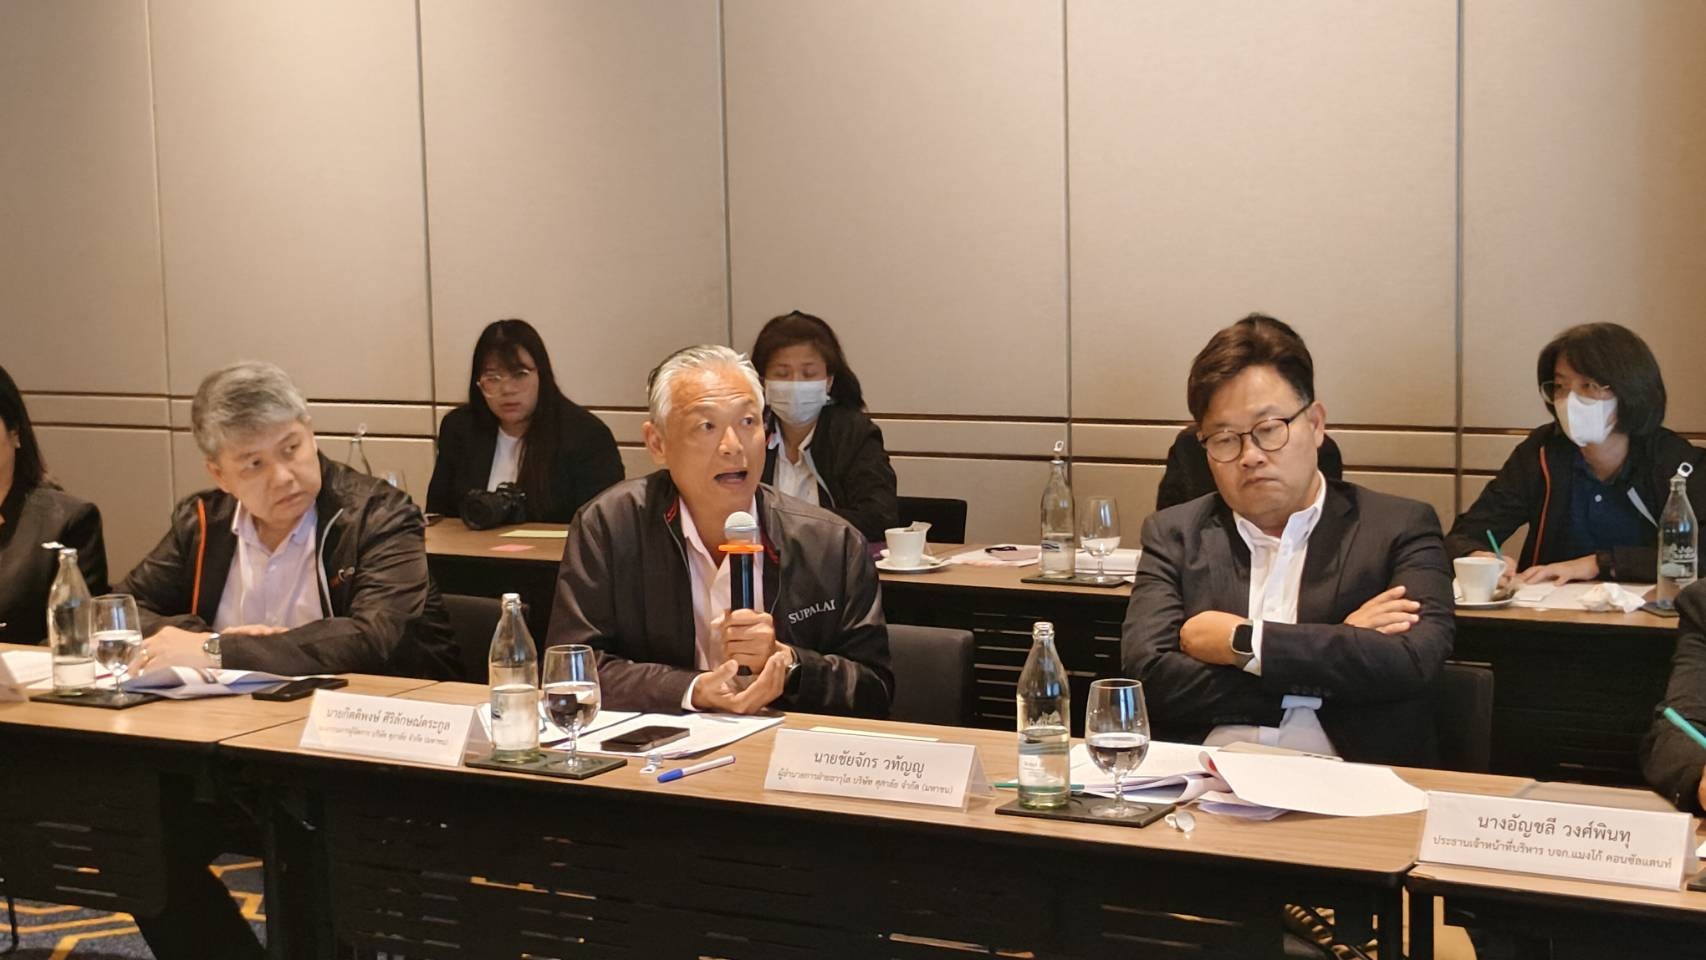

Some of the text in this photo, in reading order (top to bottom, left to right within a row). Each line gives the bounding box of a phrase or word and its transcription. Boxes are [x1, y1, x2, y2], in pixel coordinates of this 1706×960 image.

[788, 599, 836, 624] SUPALAI
[326, 707, 382, 723] นายกิตติพงษ์
[814, 750, 926, 779] นายชัยจักร วทัญญู
[853, 776, 873, 786] บริษัท
[901, 780, 920, 791] จำกัด
[922, 783, 953, 794] (มหาชน)
[1478, 813, 1632, 848] นางอัญชลี วงศ์พินทุ
[1433, 836, 1544, 856] ประธานเจ้าหน้าที่บริหาร
